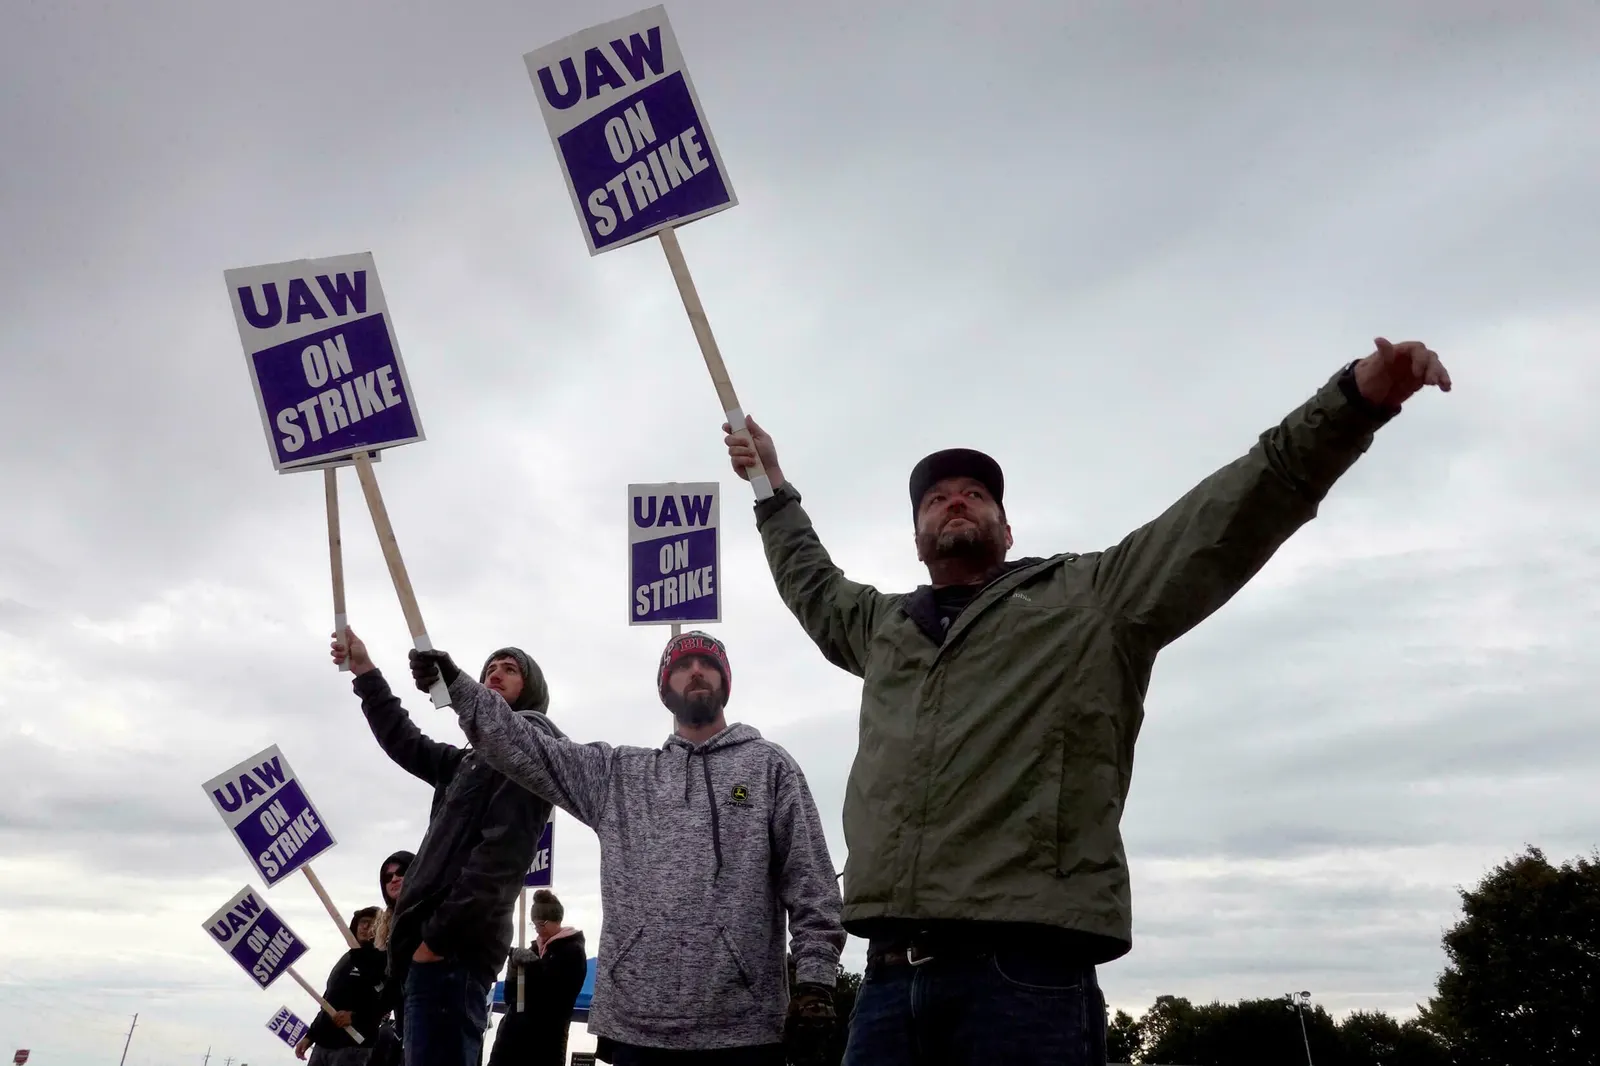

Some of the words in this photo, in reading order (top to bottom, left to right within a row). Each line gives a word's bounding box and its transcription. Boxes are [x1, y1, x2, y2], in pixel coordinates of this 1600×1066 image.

[537, 25, 665, 110] UAW
[604, 100, 657, 164] ON
[587, 126, 710, 237] STRIKE
[237, 270, 367, 329] UAW
[301, 333, 353, 388] ON
[276, 364, 402, 453] STRIKE
[633, 495, 713, 529] UAW
[659, 538, 689, 575] ON
[635, 565, 714, 617] STRIKE
[212, 756, 286, 812] UAW
[259, 807, 320, 878] STRIKE
[260, 798, 291, 837] ON
[525, 847, 549, 875] KE
[209, 893, 262, 942] UAW
[246, 925, 270, 954] ON
[252, 926, 295, 983] STRIKE
[269, 1008, 290, 1031] UAW
[284, 1021, 295, 1034] ON
[287, 1020, 305, 1046] STRIKE
